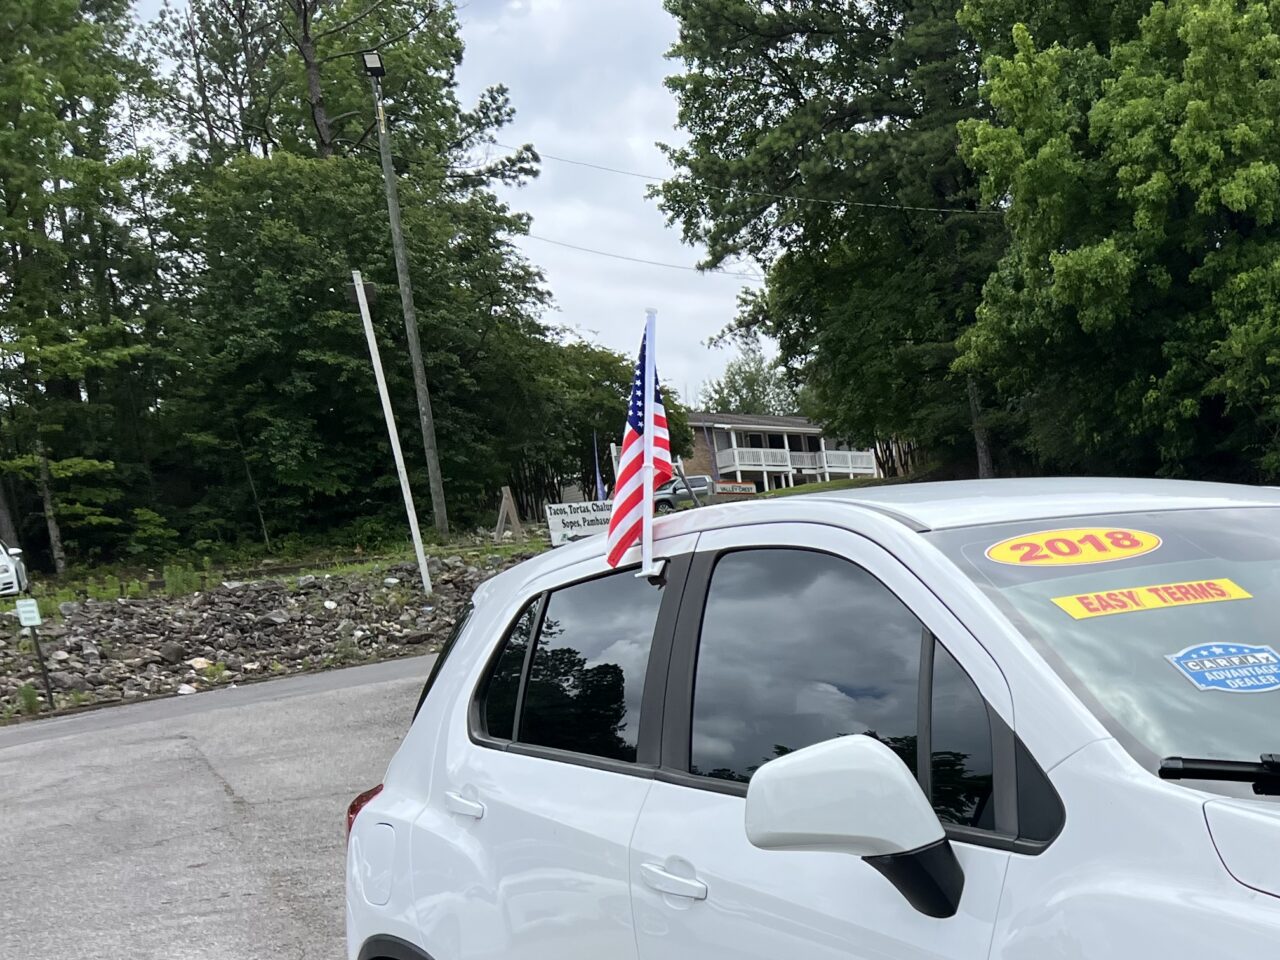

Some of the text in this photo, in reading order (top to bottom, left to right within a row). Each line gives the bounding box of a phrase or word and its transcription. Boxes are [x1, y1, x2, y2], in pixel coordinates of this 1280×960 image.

[548, 506, 568, 516] Tacos,
[568, 504, 591, 515] Tortas,
[562, 518, 582, 530] Sopes,
[1010, 531, 1142, 562] 2018
[1077, 582, 1229, 613] EASY TERMS
[1185, 653, 1277, 671] CARFAX
[1204, 664, 1280, 681] ADVANTAGE
[1226, 674, 1278, 688] DEALER
